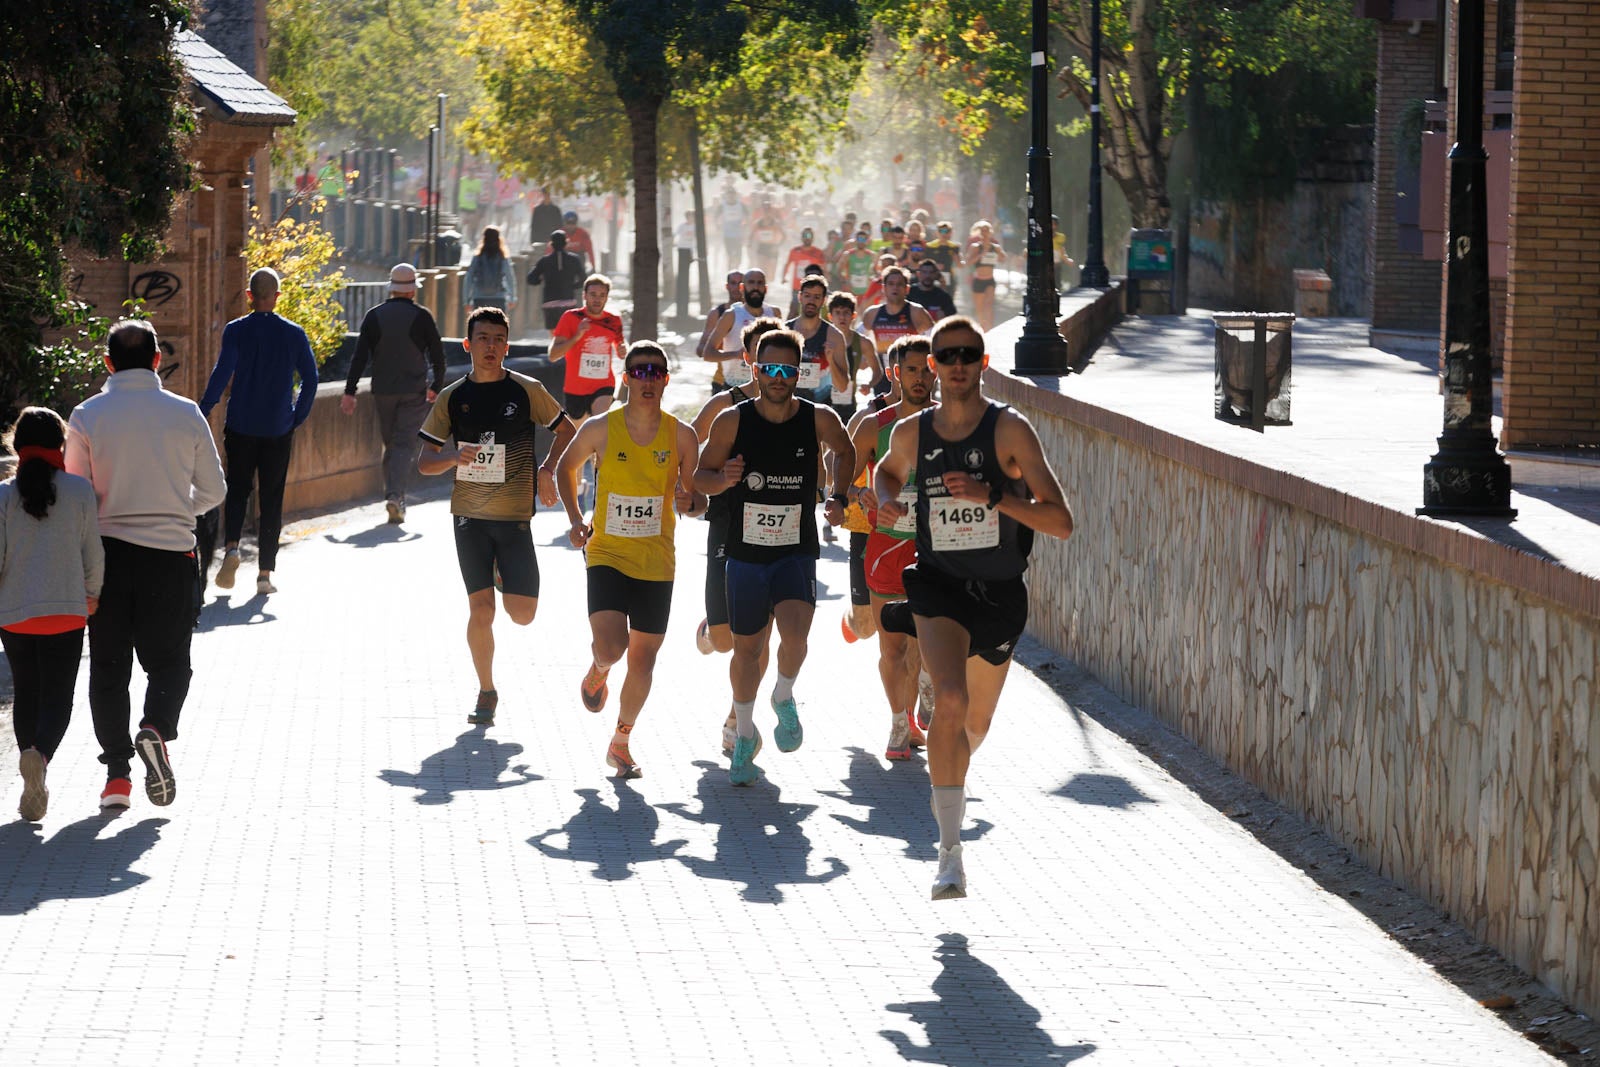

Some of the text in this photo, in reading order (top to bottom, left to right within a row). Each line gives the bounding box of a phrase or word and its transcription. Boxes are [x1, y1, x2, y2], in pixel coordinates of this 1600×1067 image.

[766, 475, 803, 484] PAUMAR
[615, 504, 653, 518] 1154
[938, 506, 985, 525] 1469
[757, 513, 786, 527] 257
